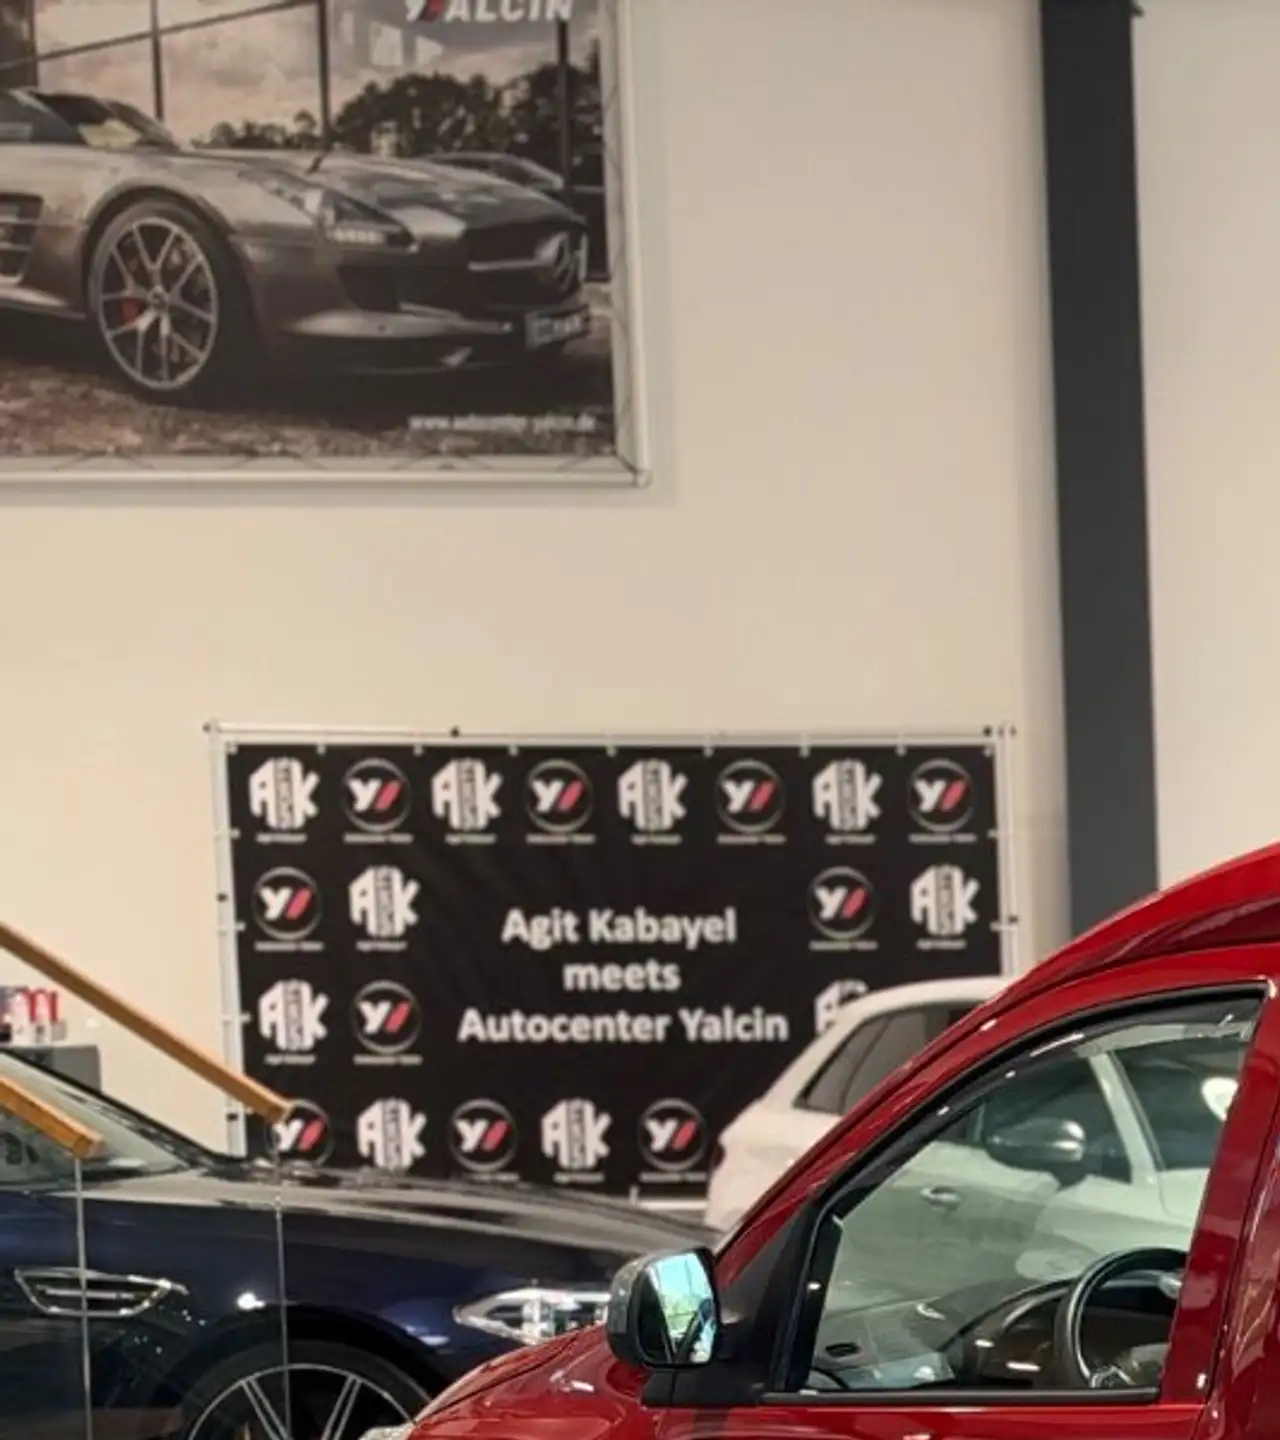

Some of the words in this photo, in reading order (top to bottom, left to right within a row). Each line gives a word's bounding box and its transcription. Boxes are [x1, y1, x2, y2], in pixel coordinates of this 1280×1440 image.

[501, 906, 581, 951] Agit
[588, 905, 737, 951] Kabayel
[562, 958, 682, 991] meets
[457, 1008, 671, 1043] Autocenter
[677, 1005, 790, 1043] Yalcin
